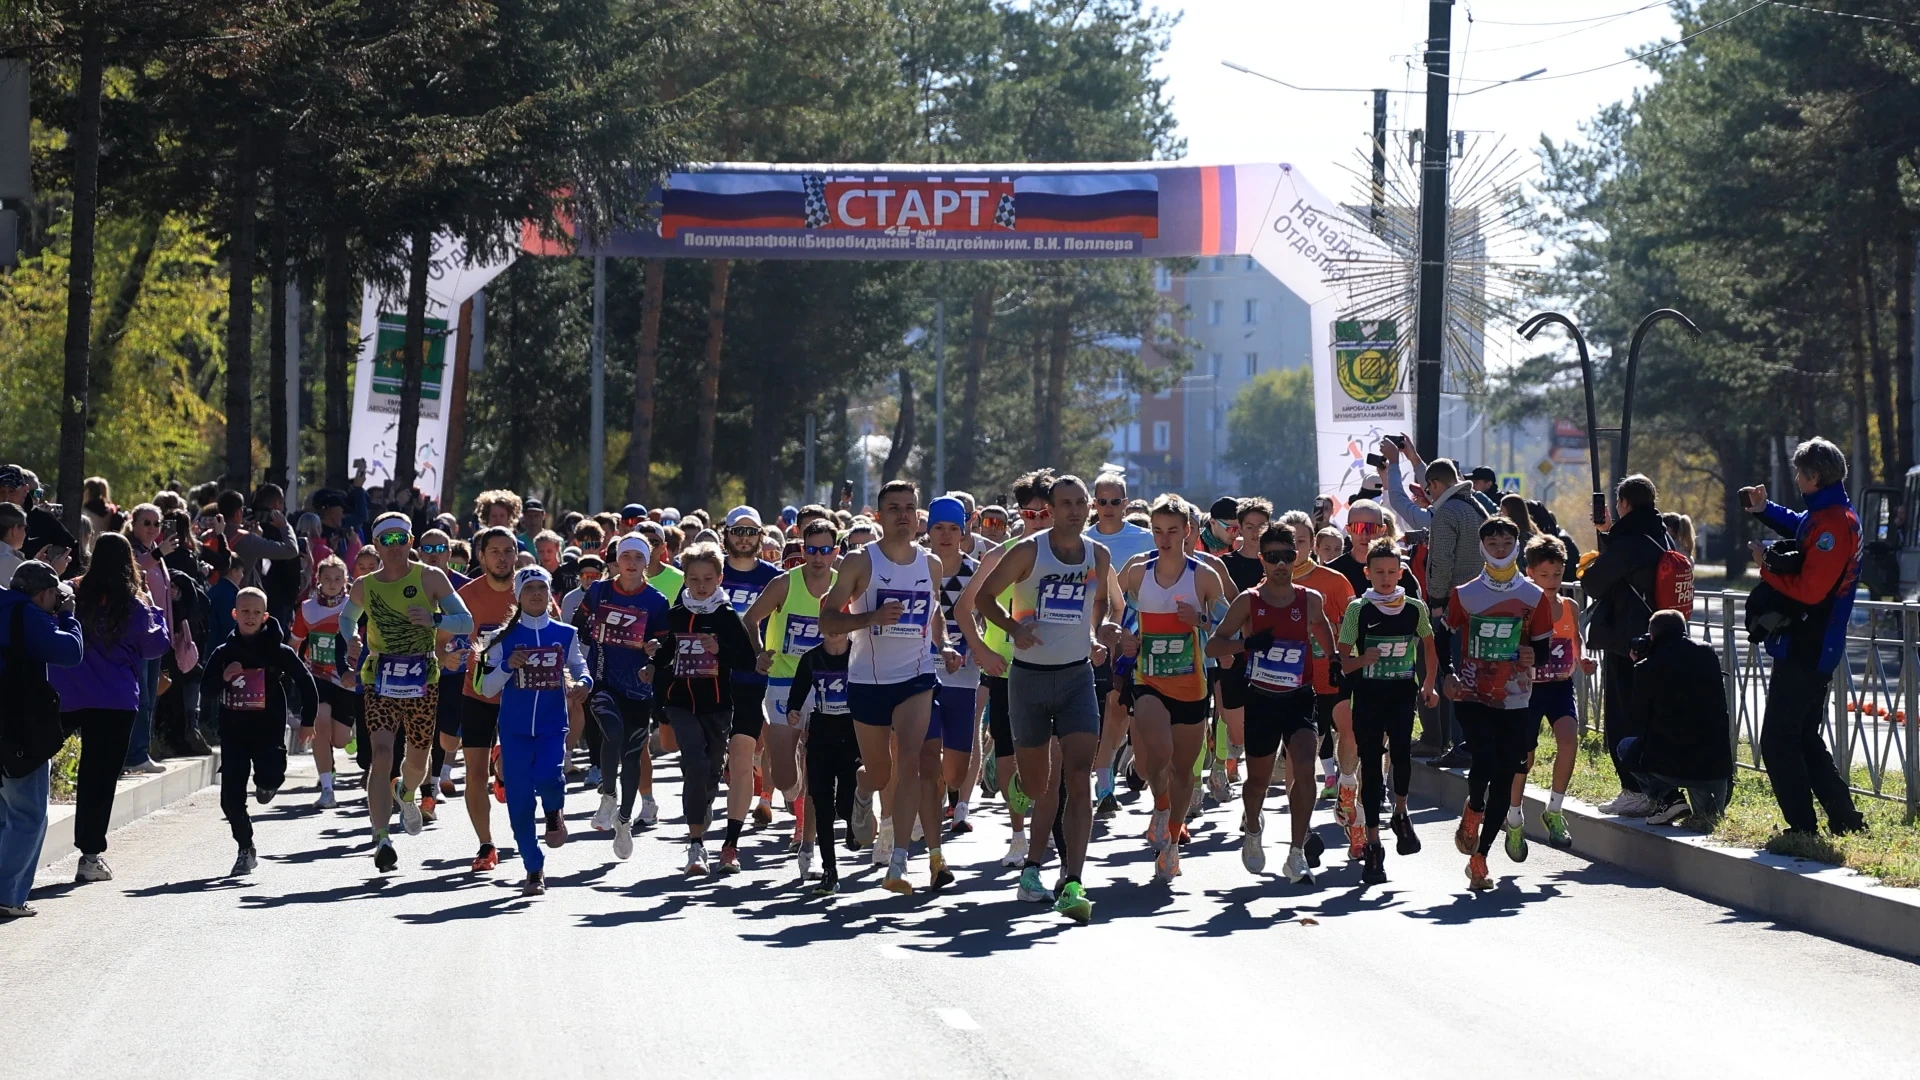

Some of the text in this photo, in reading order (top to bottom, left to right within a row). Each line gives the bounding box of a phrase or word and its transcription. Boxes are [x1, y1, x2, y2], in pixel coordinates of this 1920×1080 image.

[837, 188, 989, 227] СТАРТ
[684, 232, 797, 248] Полумарафон
[1004, 238, 1030, 250] им.
[1034, 237, 1060, 250] В.И.
[1064, 237, 1133, 251] Пеллера
[1273, 215, 1345, 281] Отделка
[1041, 583, 1085, 600] 191
[883, 597, 927, 615] 12
[606, 611, 638, 627] 67
[788, 621, 825, 638] 39
[1479, 622, 1514, 638] 86
[1150, 639, 1185, 655] 89
[1376, 642, 1409, 658] 85
[526, 652, 558, 668] 43
[381, 661, 423, 677] 154
[231, 675, 246, 689] 4
[818, 678, 848, 693] 14
